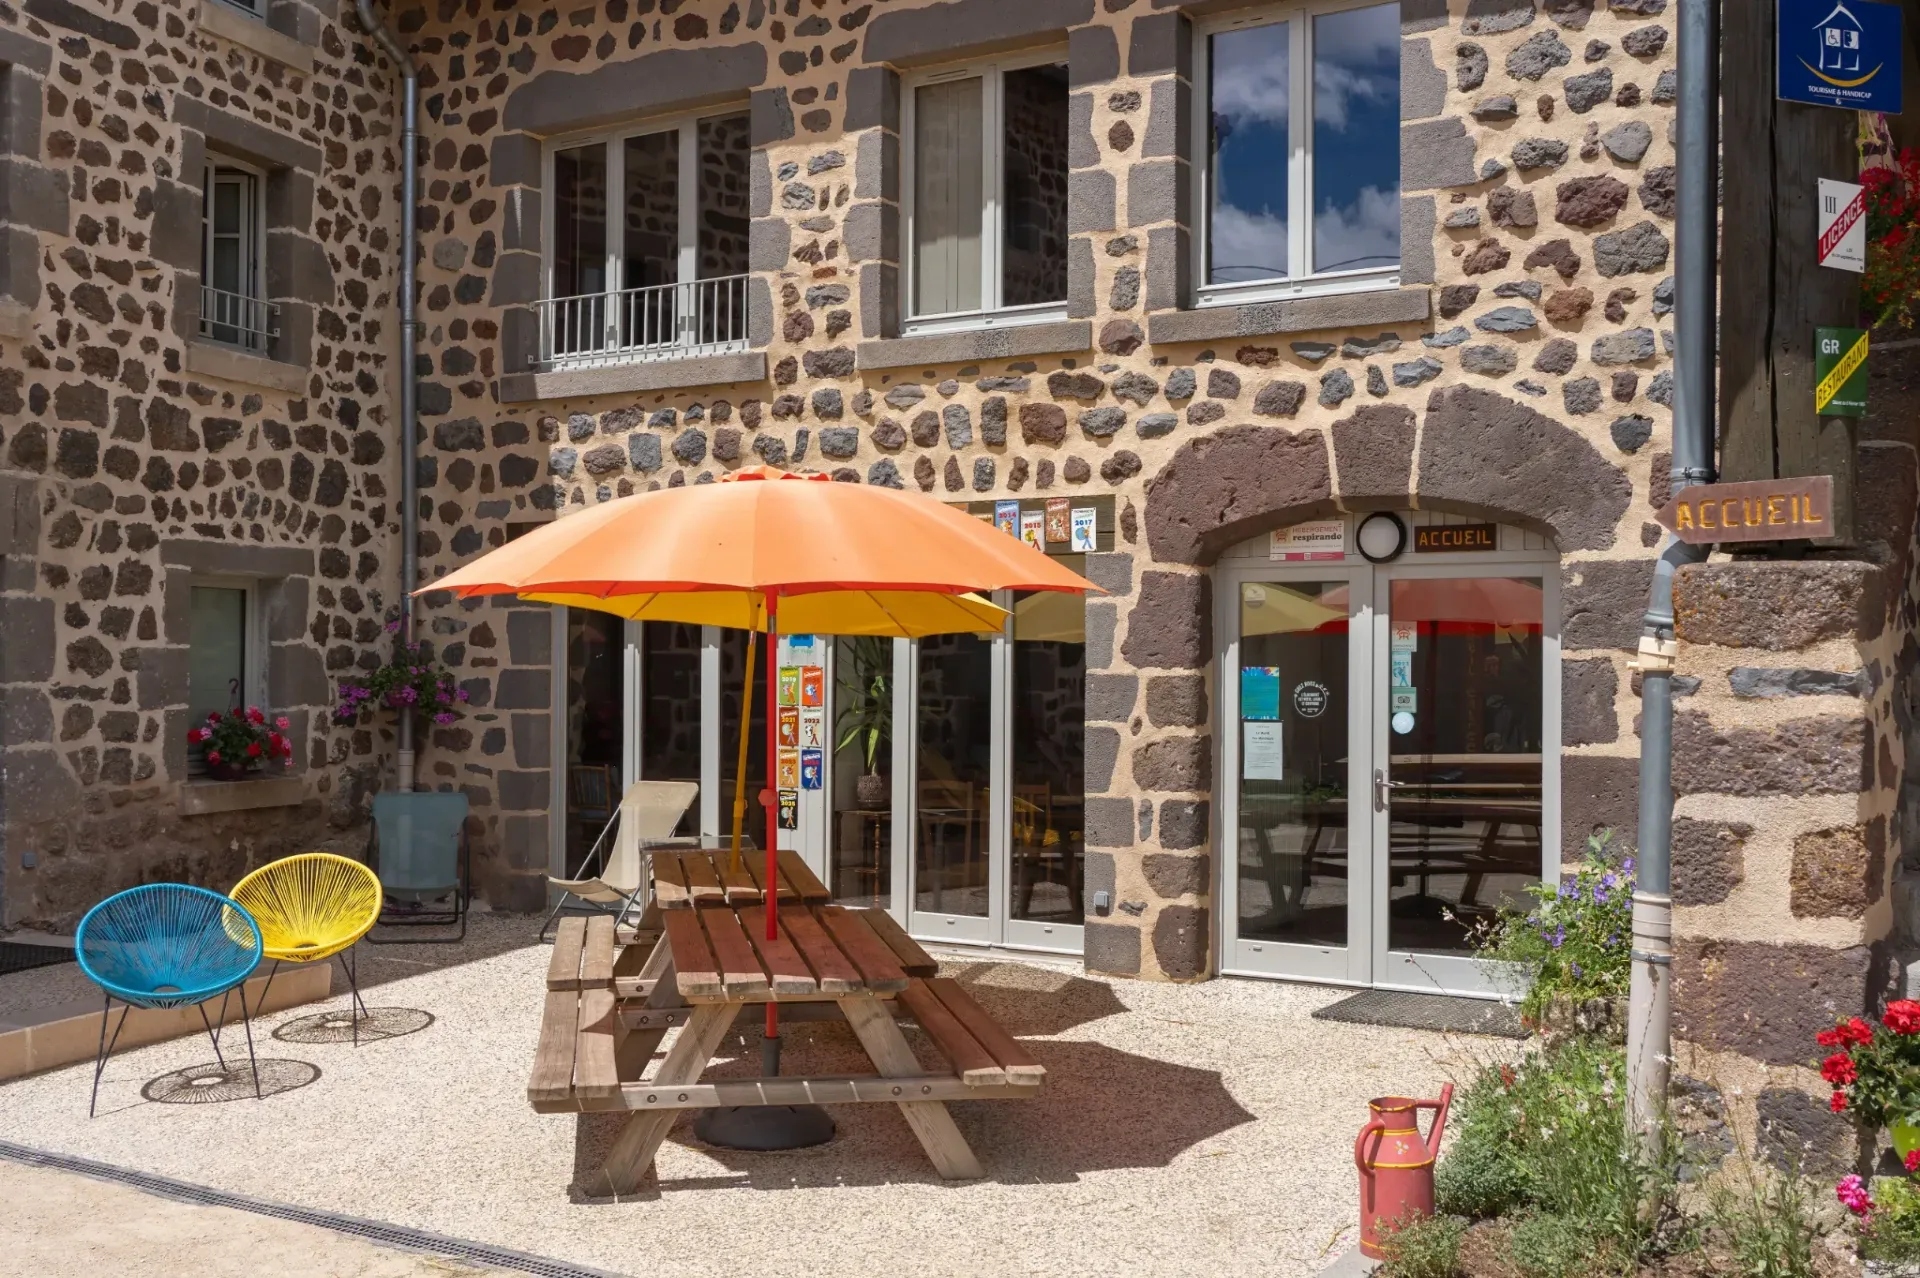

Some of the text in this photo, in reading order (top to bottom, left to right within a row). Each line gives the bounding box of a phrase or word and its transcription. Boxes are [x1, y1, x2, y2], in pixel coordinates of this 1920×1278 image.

[1808, 85, 1836, 95] TOURISME
[1842, 90, 1872, 99] HANDICAP
[1825, 195, 1836, 214] III
[1822, 194, 1863, 257] LICENCE
[1821, 339, 1840, 354] GR
[1818, 337, 1867, 412] RESTAURANT
[1676, 493, 1823, 530] ACCUEIL
[1292, 533, 1342, 542] respirando
[1419, 529, 1492, 546] ACCUEIL
